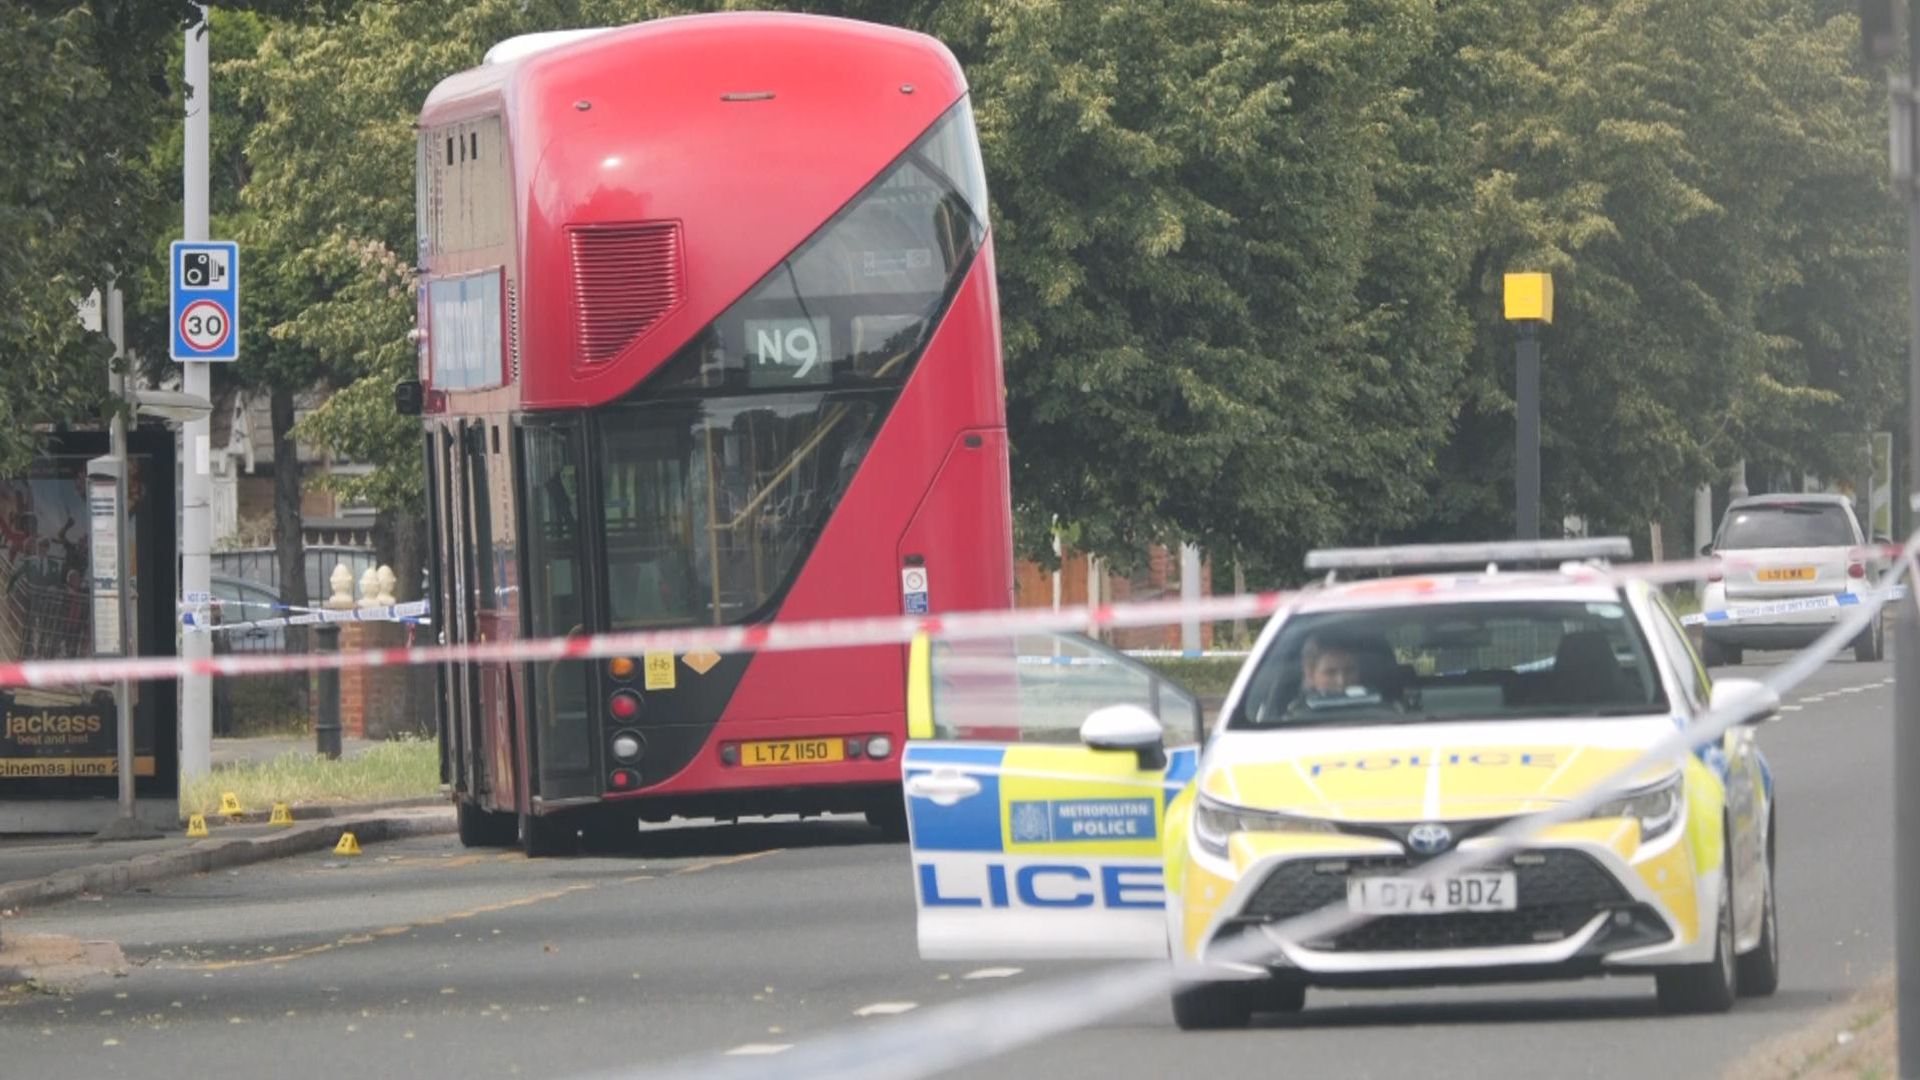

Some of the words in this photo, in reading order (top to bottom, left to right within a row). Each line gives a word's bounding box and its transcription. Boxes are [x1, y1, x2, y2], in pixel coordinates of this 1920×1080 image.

[188, 315, 222, 335] 30
[758, 328, 818, 378] N9
[5, 711, 102, 739] jackass
[17, 733, 42, 745] best
[44, 733, 65, 745] and
[755, 743, 790, 762] LTZ
[795, 741, 828, 760] 1150
[70, 760, 106, 777] june
[1311, 753, 1557, 776] POLICE
[1059, 803, 1148, 818] METROPOLITAN
[1072, 820, 1137, 835] POLICE
[1446, 878, 1503, 906] BDZ
